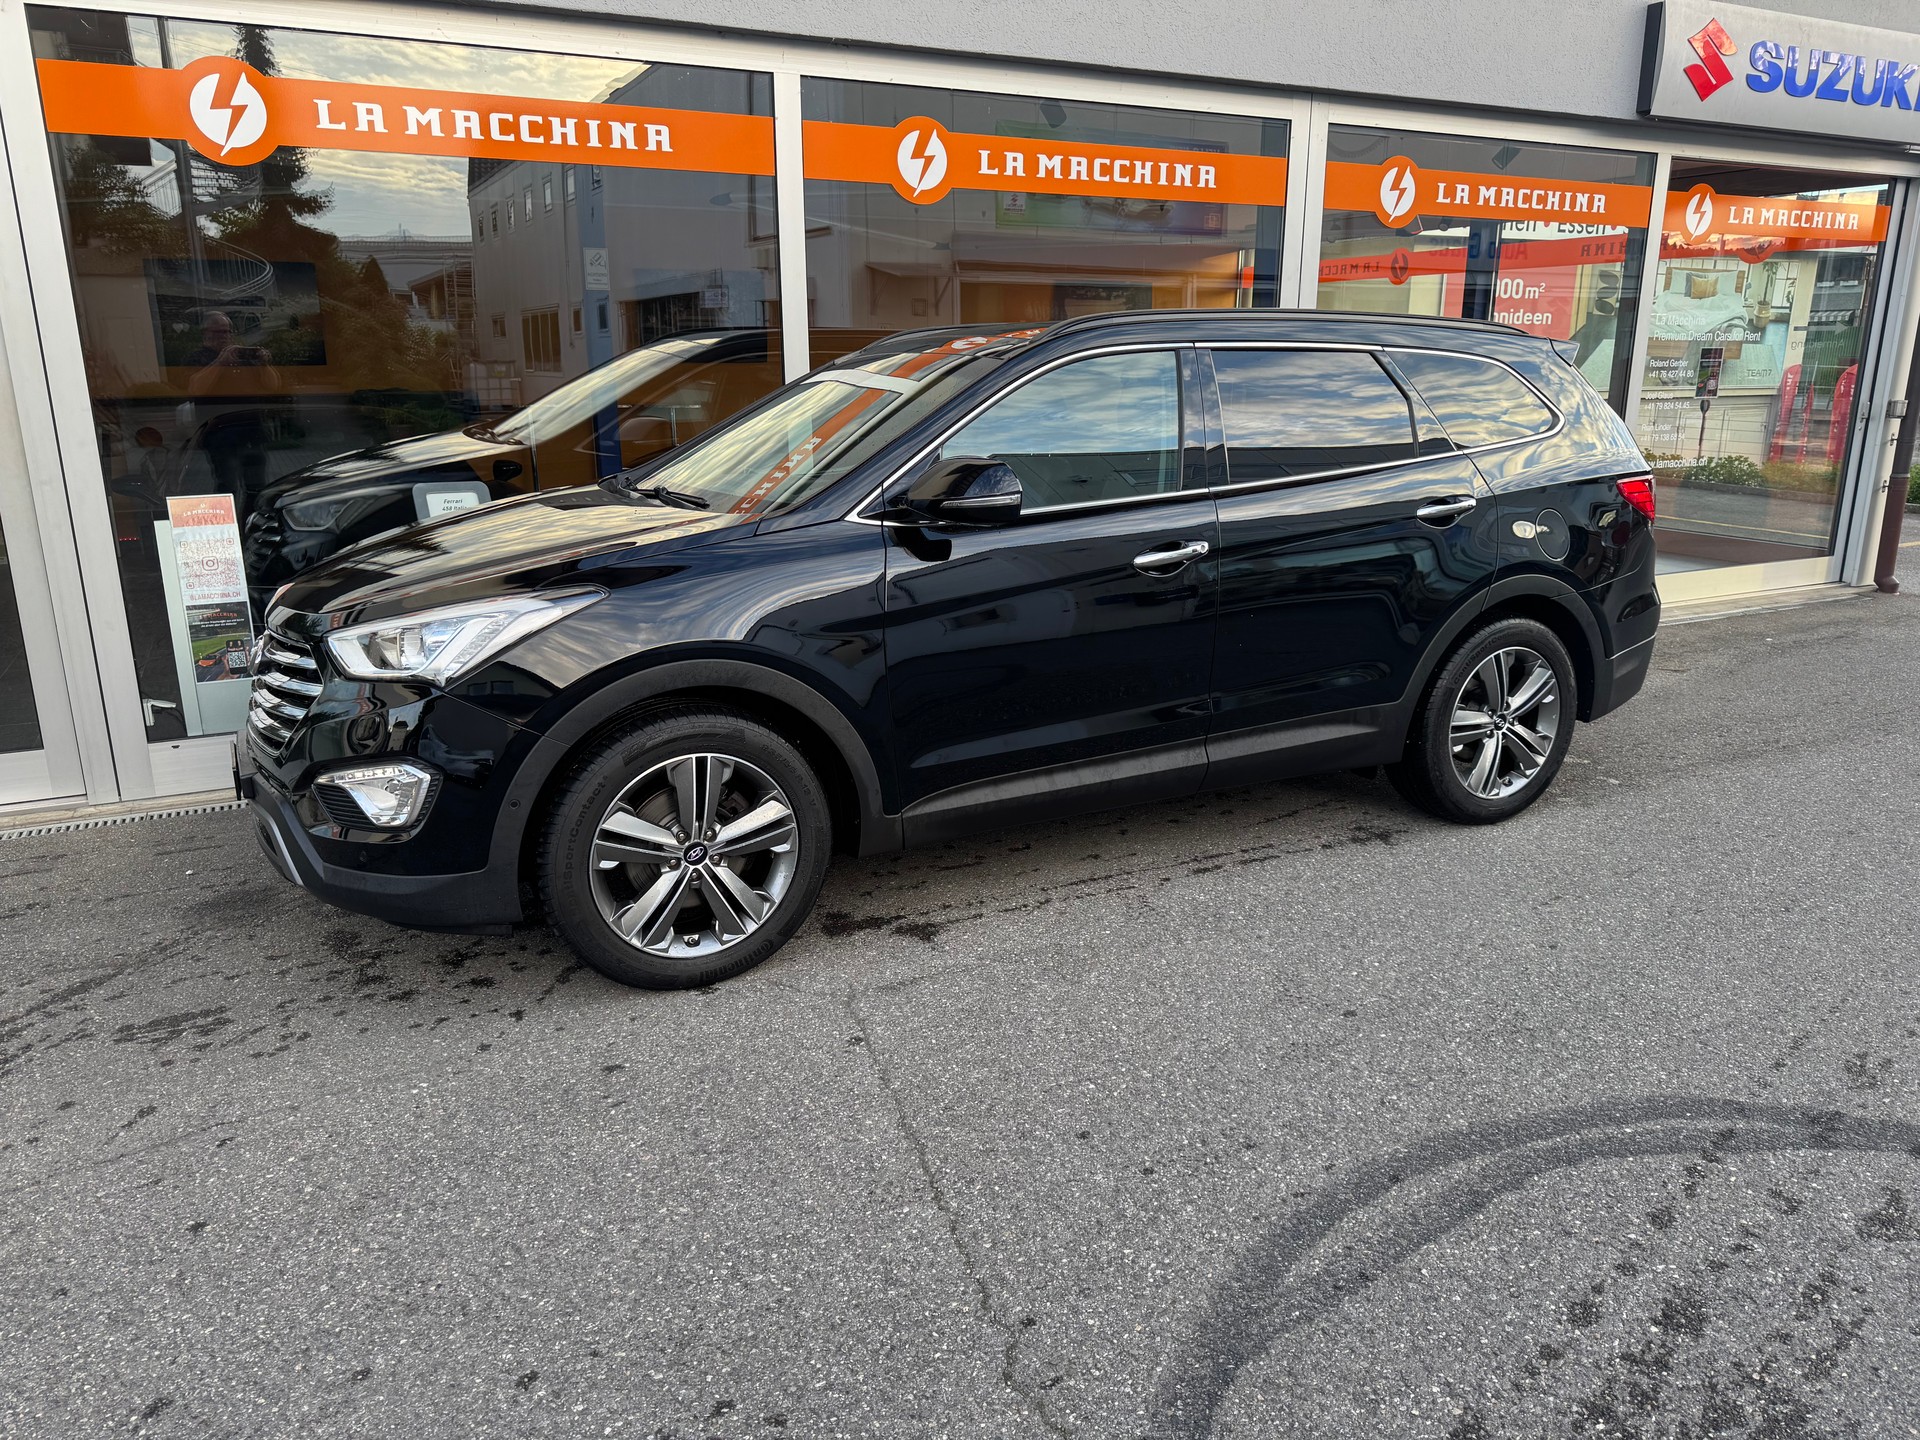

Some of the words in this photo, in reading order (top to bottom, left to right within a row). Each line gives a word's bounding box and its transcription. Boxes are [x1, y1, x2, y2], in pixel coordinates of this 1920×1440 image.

[312, 98, 388, 134] LA
[403, 105, 673, 153] MACCHINA
[978, 149, 1026, 177] LA
[1036, 153, 1217, 188] MACCHINA
[1436, 182, 1470, 205] LA
[1476, 186, 1606, 214] MACCHINA
[1728, 206, 1755, 225] LA
[1758, 208, 1859, 230] MACCHINA
[1653, 331, 1687, 341] Premium
[1688, 331, 1713, 341] Dream
[1714, 331, 1731, 341] Cars
[1744, 330, 1761, 341] Rent
[1649, 359, 1669, 367] Roland
[1670, 359, 1689, 367] Gerber
